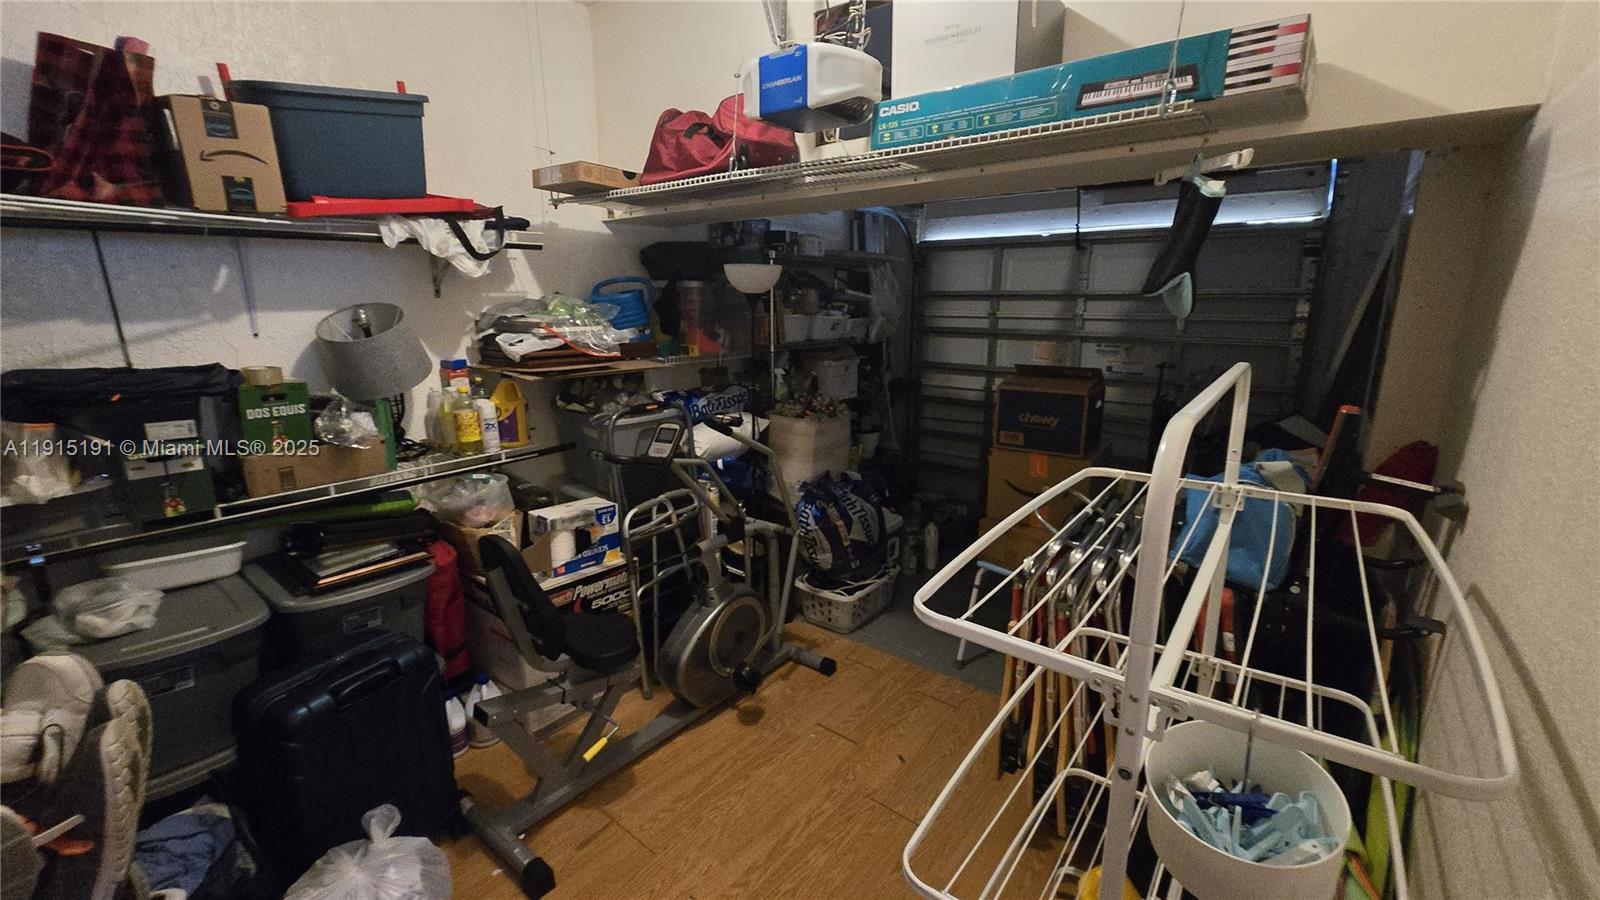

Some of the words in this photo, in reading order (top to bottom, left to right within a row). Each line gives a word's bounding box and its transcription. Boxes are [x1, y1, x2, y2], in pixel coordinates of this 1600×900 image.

[879, 101, 920, 118] CASIO
[246, 408, 271, 420] DOS
[272, 404, 306, 417] EQUIS
[1018, 411, 1060, 428] chewy
